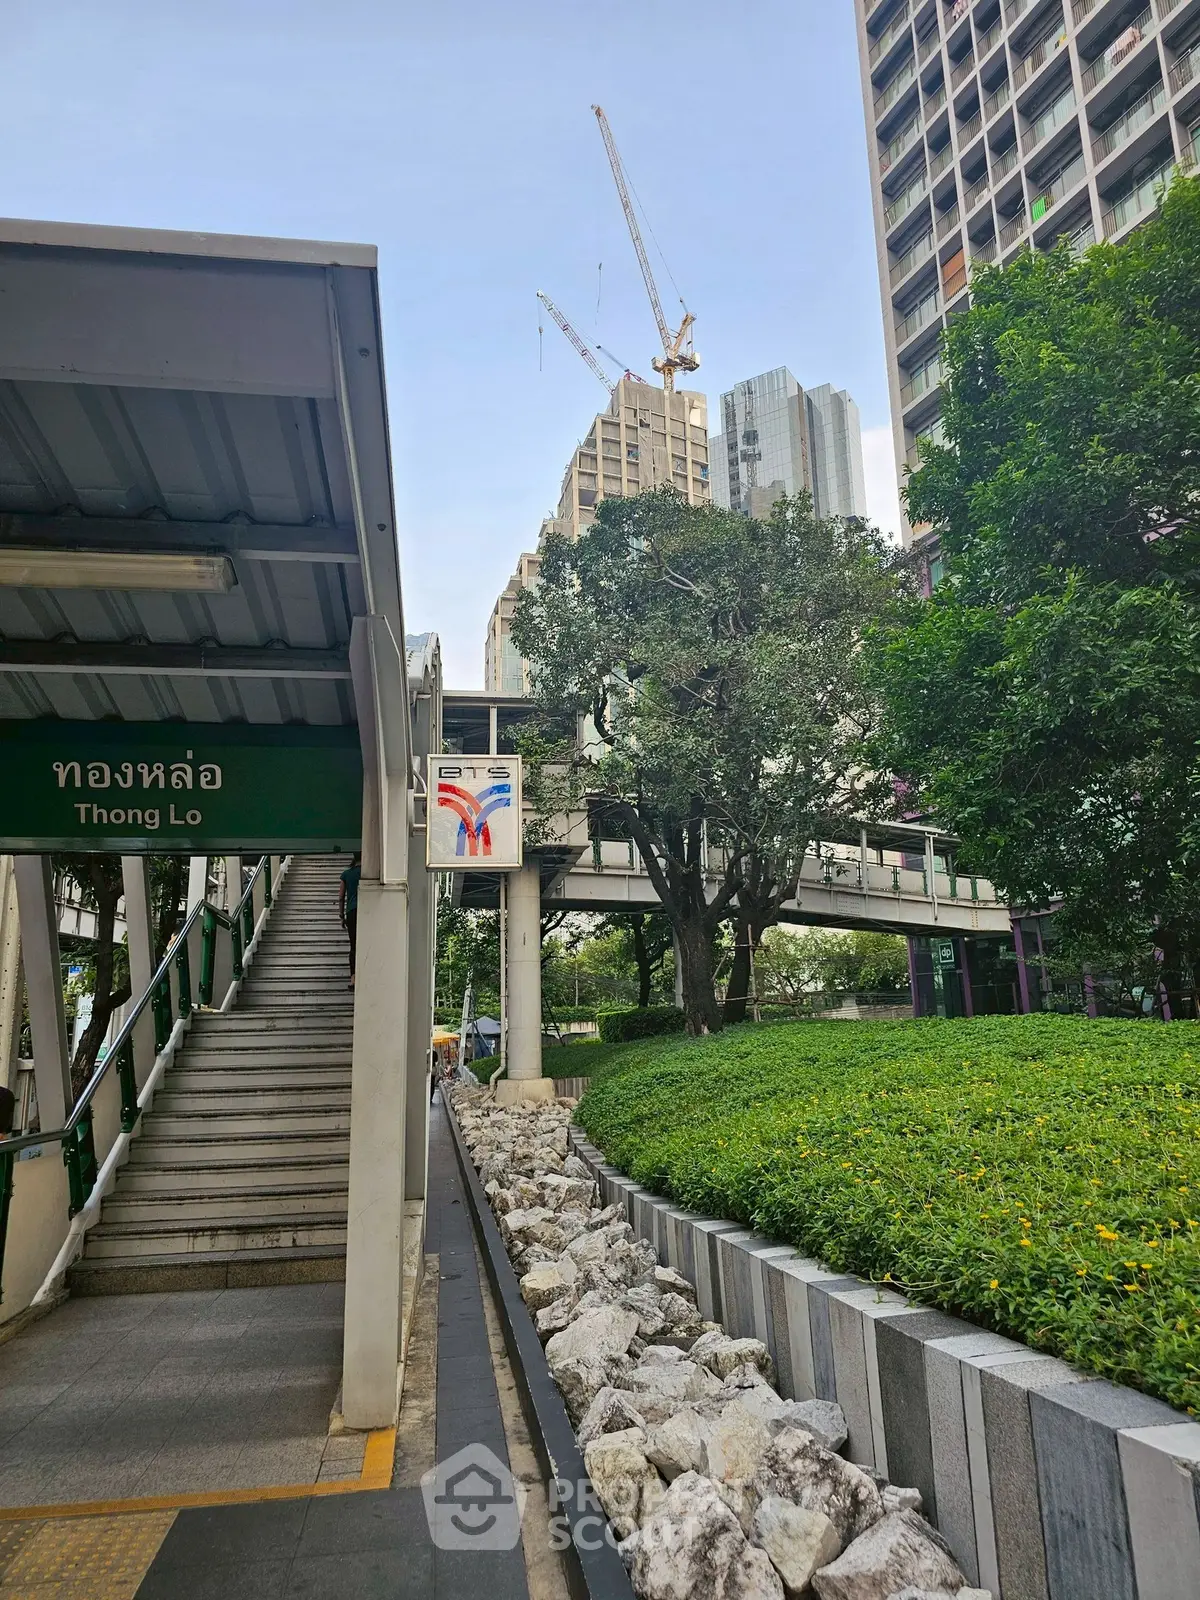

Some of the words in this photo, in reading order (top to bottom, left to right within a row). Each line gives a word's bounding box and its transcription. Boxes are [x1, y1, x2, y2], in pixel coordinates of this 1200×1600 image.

[52, 749, 223, 790] ทองหล่อ
[438, 766, 511, 779] BTS
[74, 803, 160, 830] Thong
[169, 803, 202, 825] Lo
